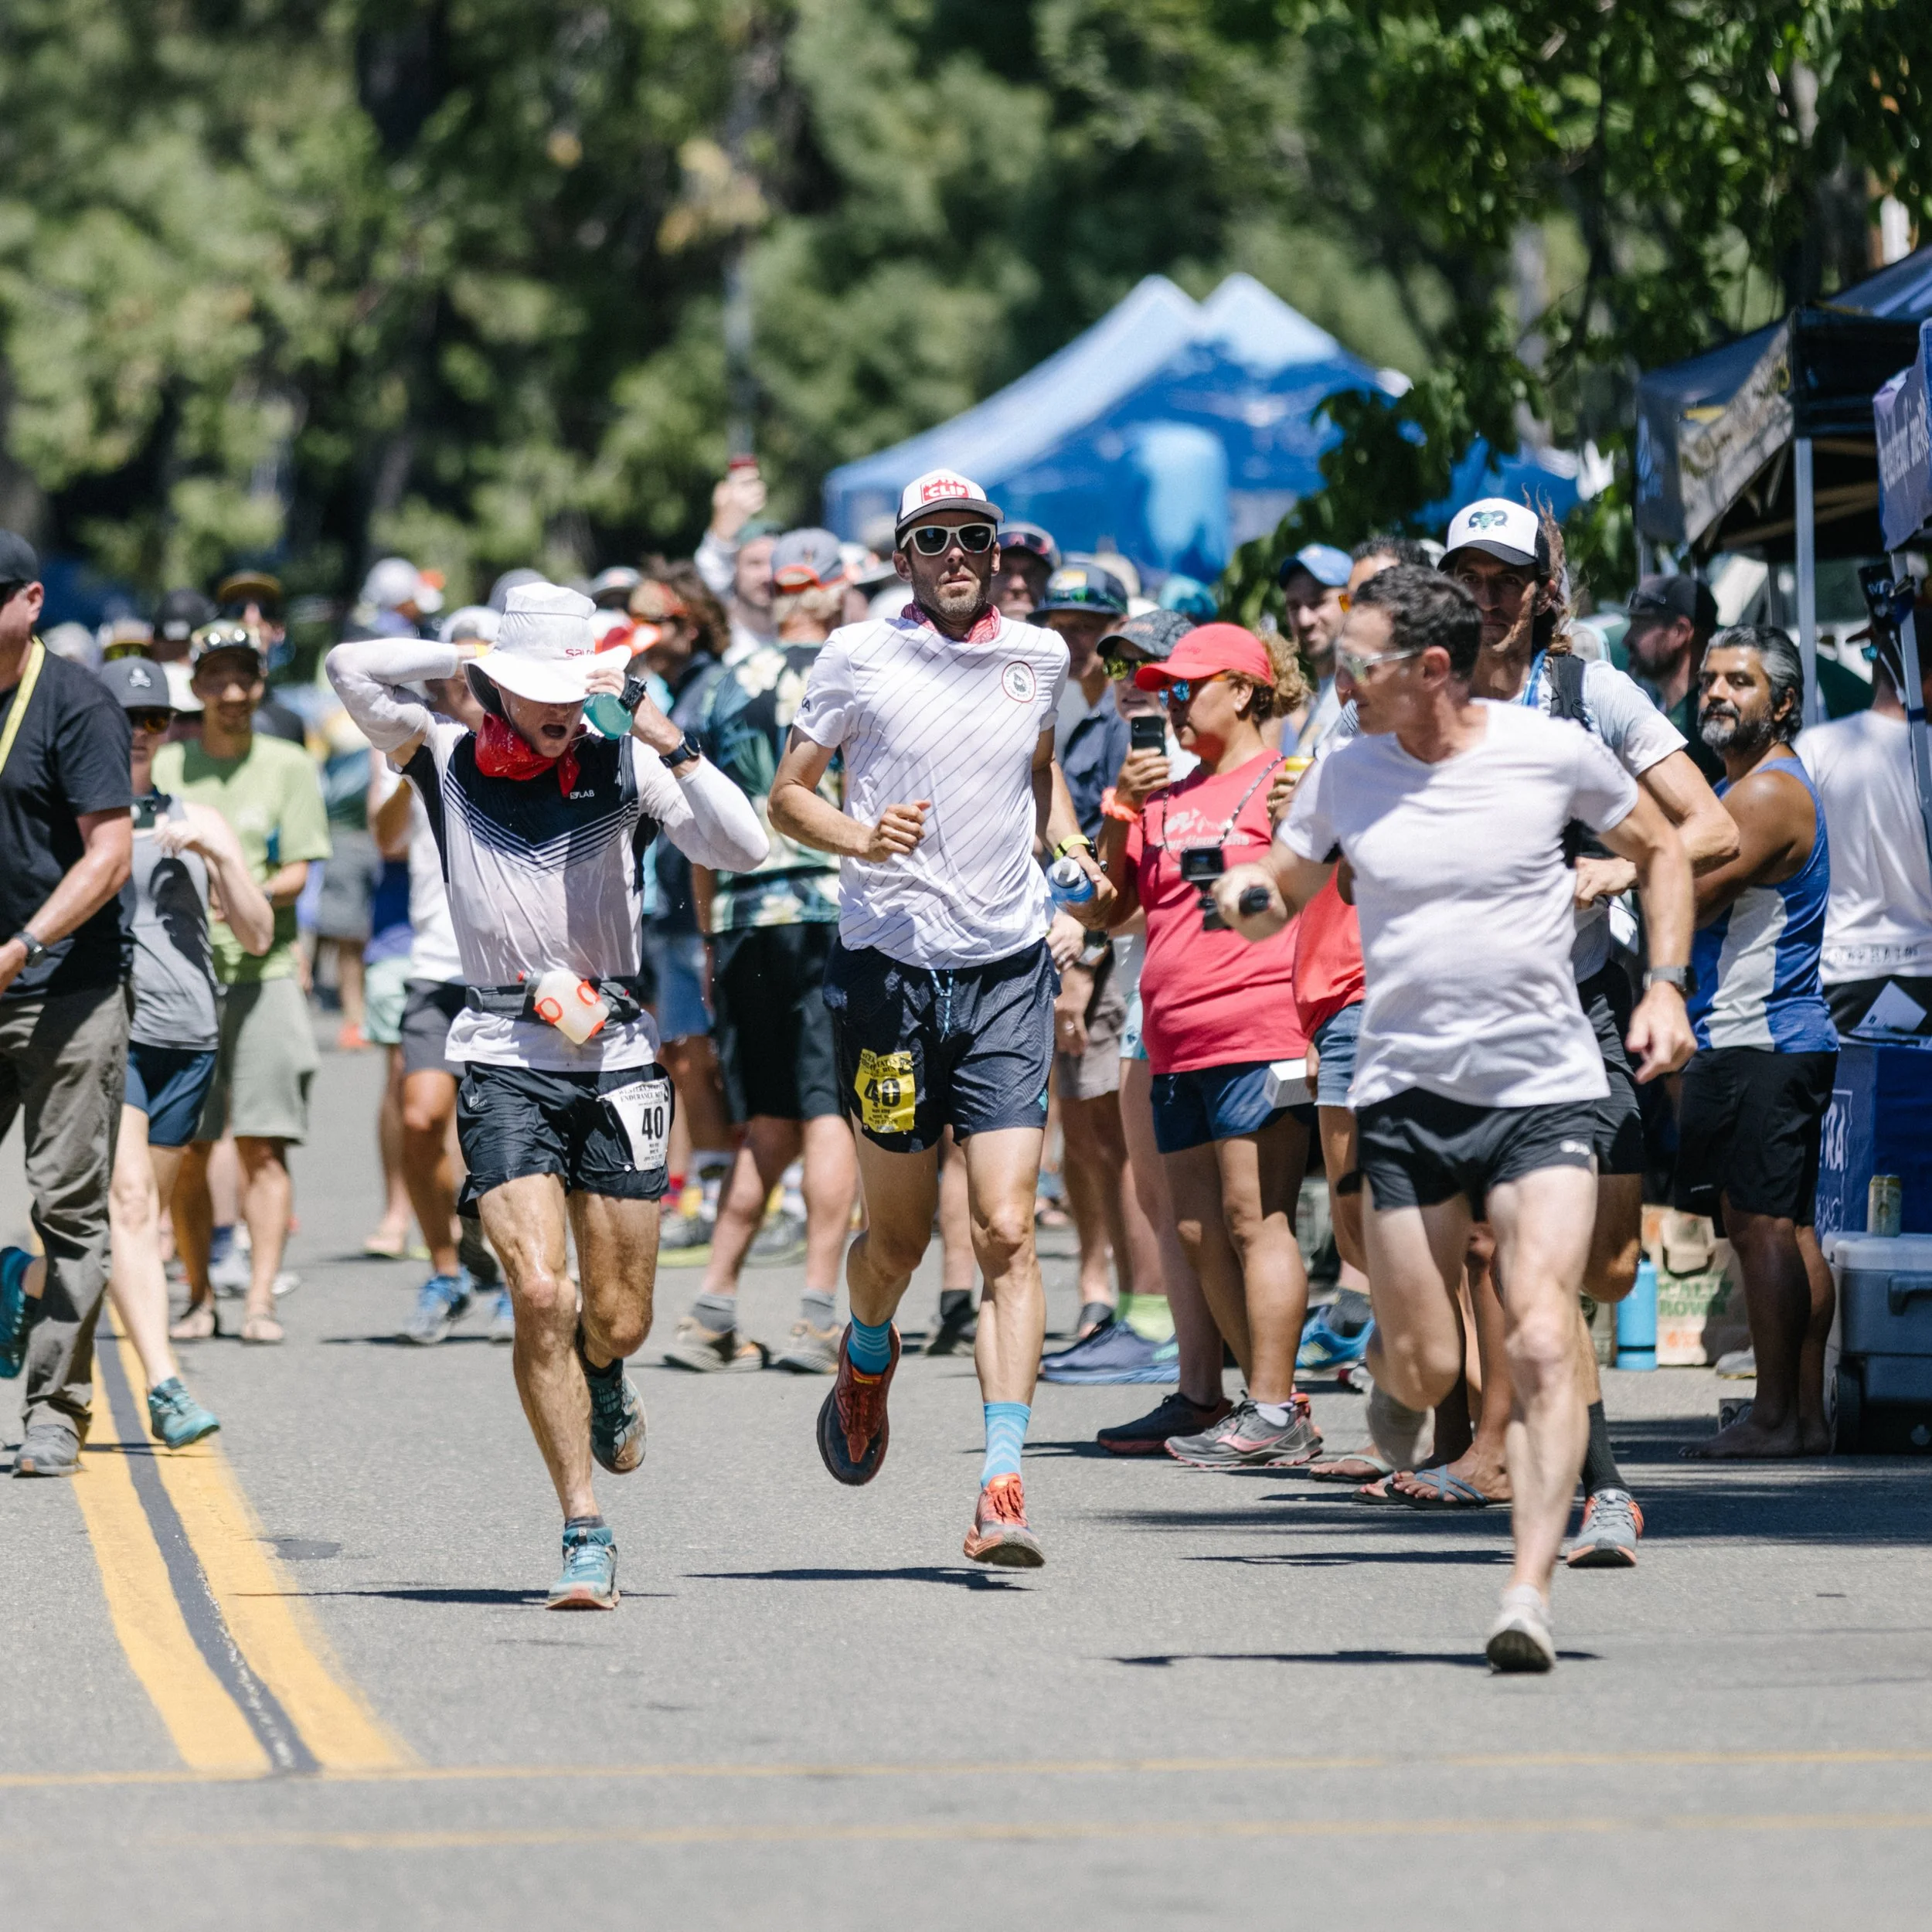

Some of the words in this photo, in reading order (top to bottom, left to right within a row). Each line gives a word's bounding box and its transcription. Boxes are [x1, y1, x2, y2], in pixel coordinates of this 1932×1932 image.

[928, 485, 966, 498] CLIF
[864, 1077, 901, 1108] 40
[642, 1105, 664, 1141] 40
